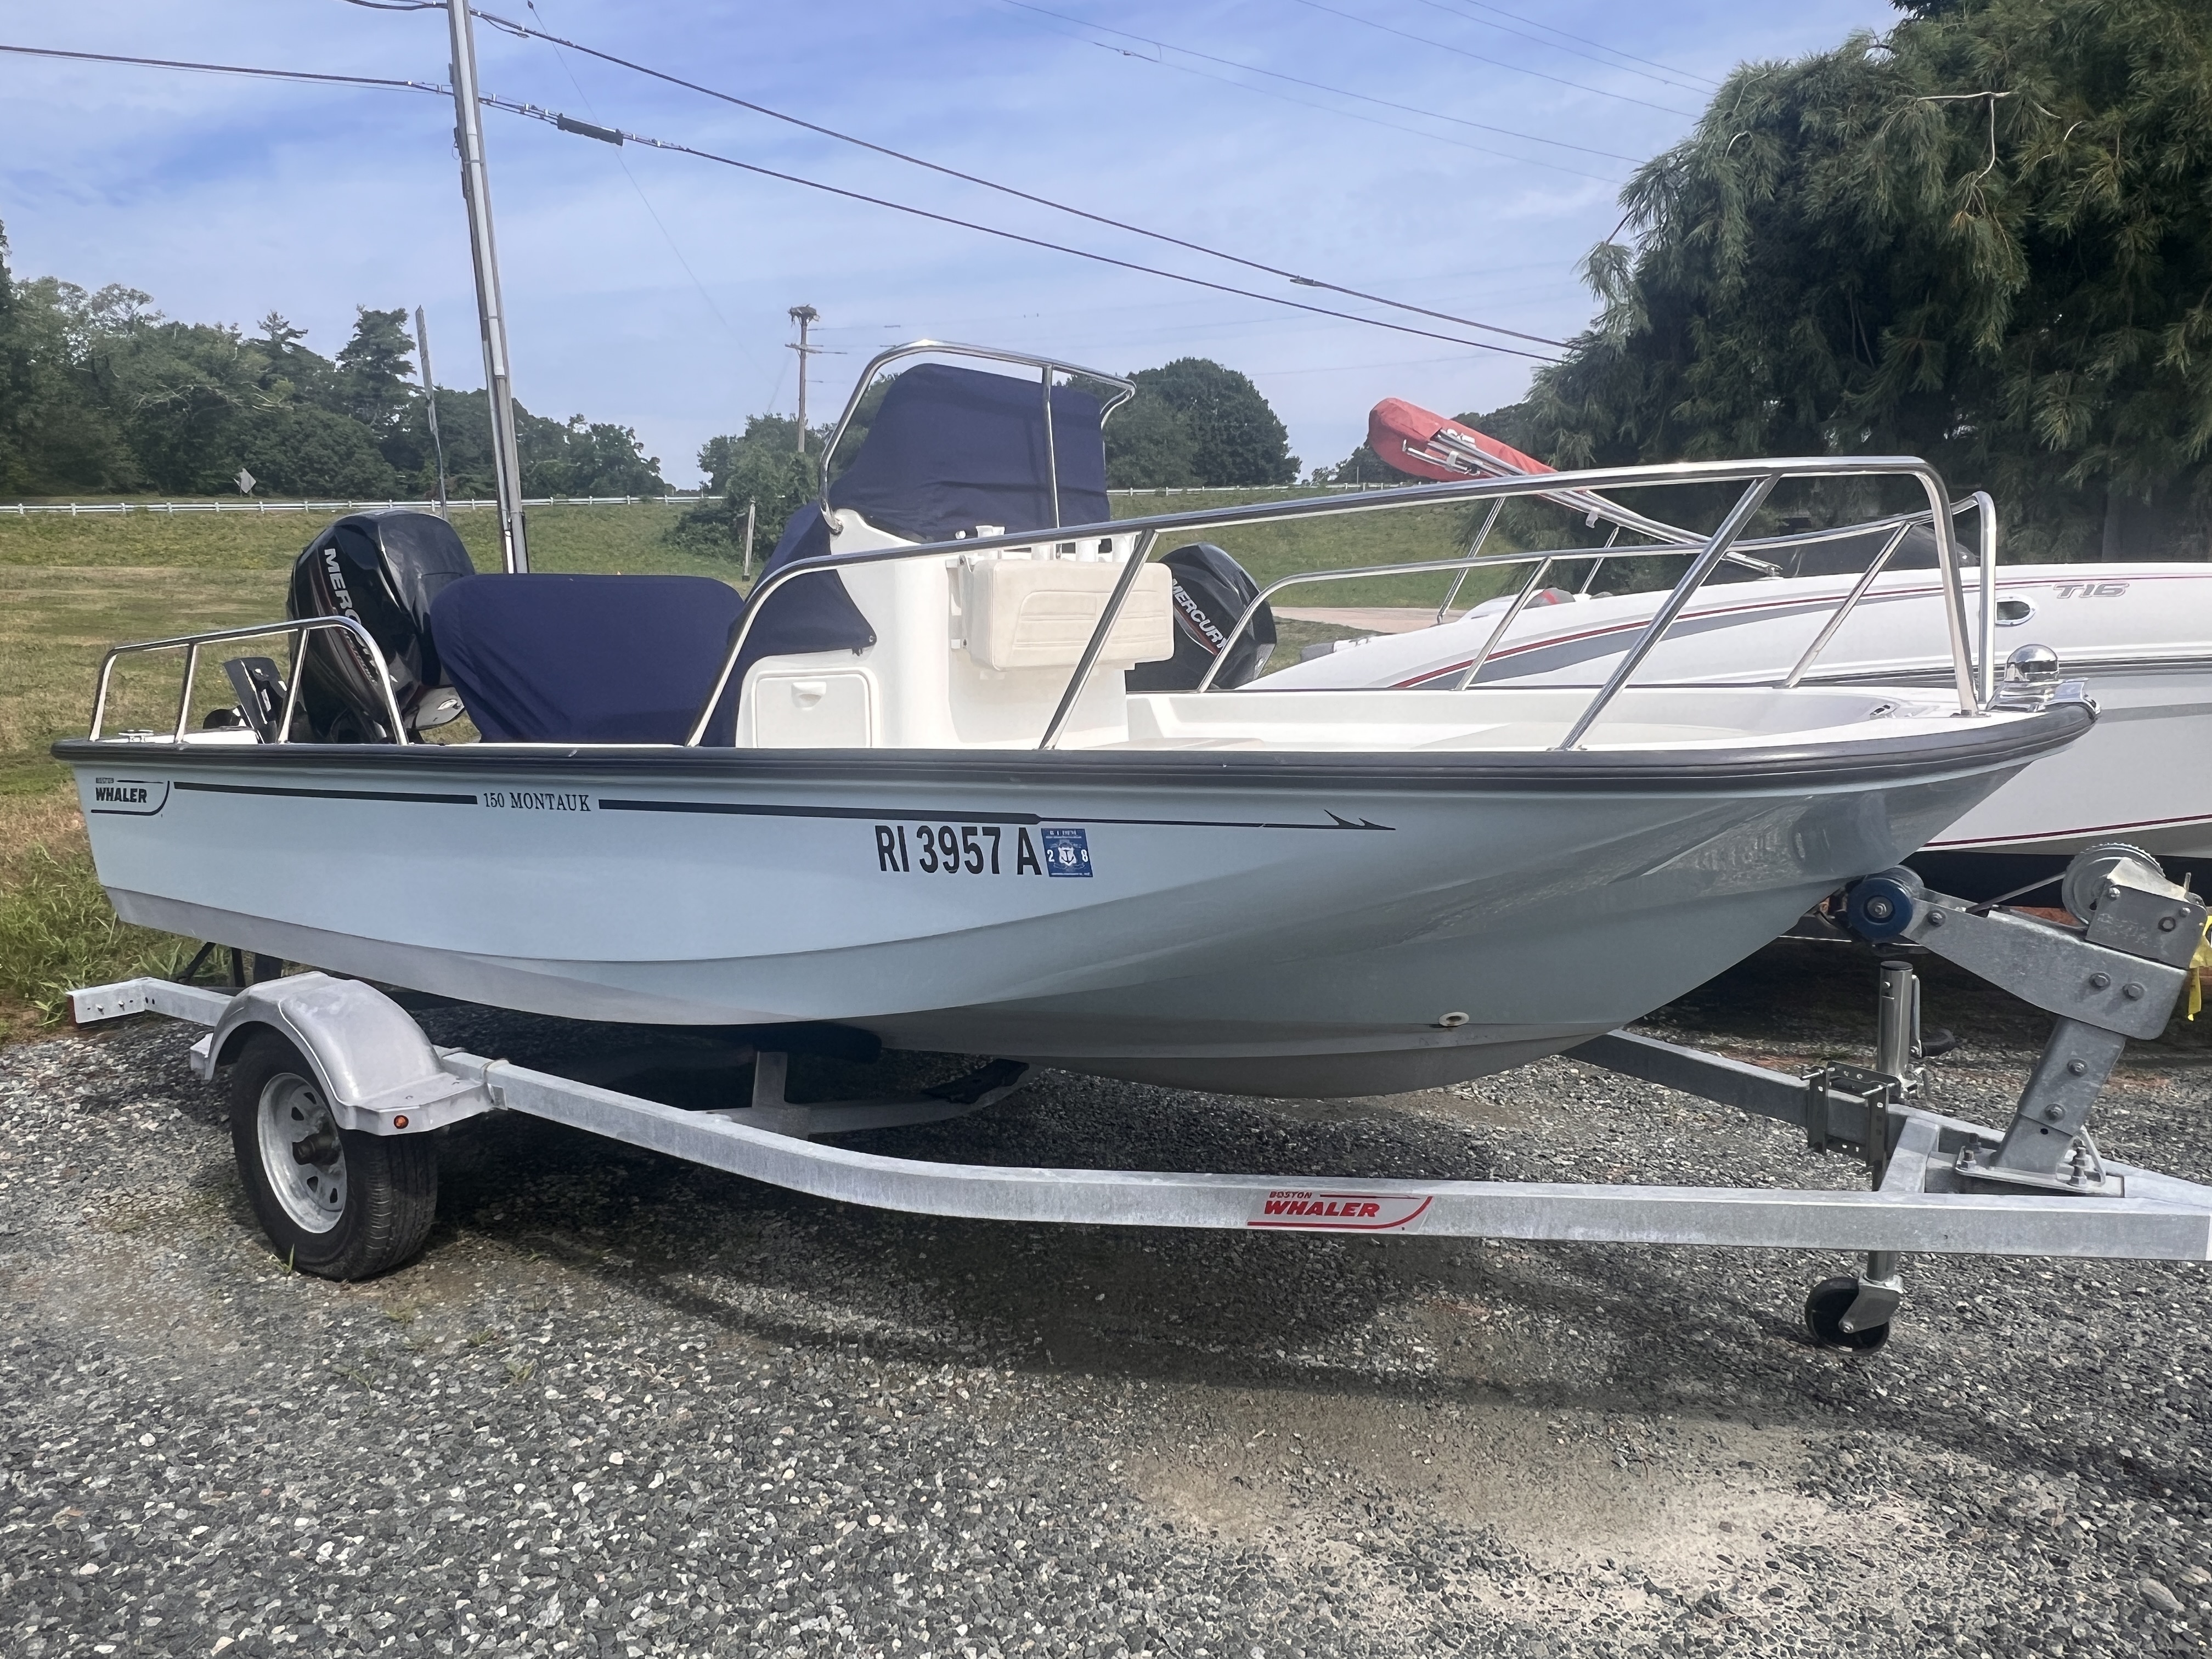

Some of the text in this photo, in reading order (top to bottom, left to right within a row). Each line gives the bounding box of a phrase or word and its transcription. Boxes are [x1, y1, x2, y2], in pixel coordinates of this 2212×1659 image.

[1172, 578, 1228, 648] MERCURY
[95, 787, 147, 803] WHALER
[483, 792, 591, 811] 150 MONTAUK
[875, 825, 1042, 875] RI 3957 A
[1269, 1191, 1312, 1199] BOSTON
[1264, 1200, 1380, 1217] WHALER
